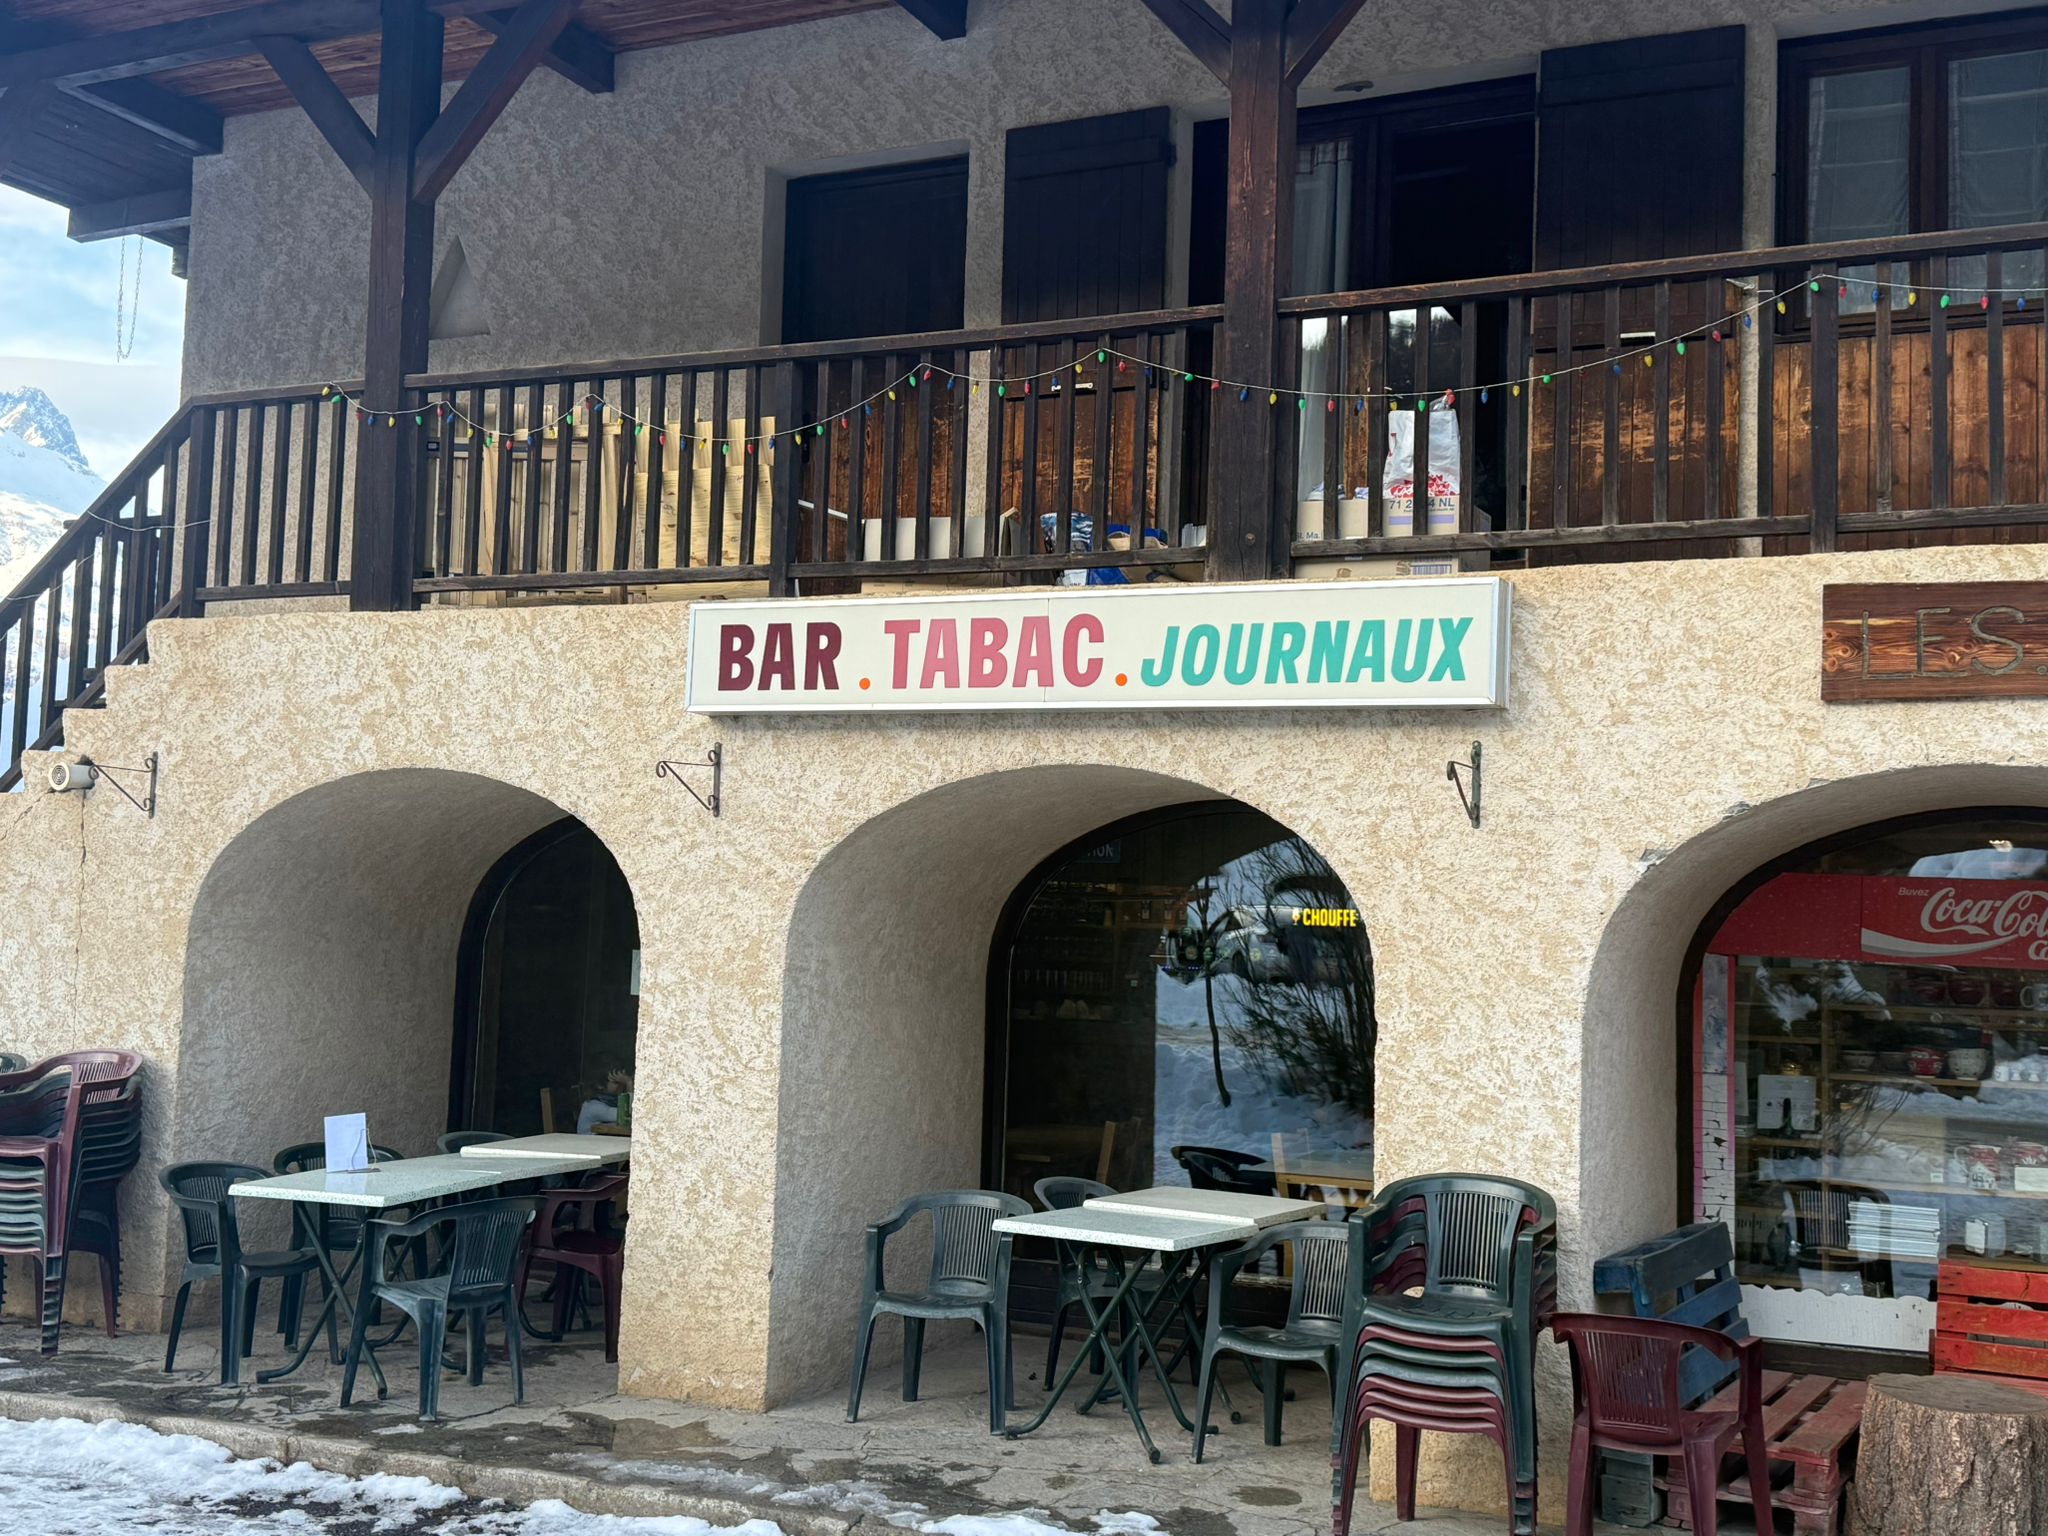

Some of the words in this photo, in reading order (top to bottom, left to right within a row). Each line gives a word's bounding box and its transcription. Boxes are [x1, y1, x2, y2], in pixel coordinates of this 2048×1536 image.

[1439, 497, 1455, 507] NL
[718, 622, 842, 691] BAR
[885, 614, 1104, 689] TABAC
[1141, 617, 1473, 687] JOURNAUX
[1862, 605, 2025, 680] LES
[1898, 887, 1930, 897] Buvez
[1302, 907, 1357, 927] CHOUFFE
